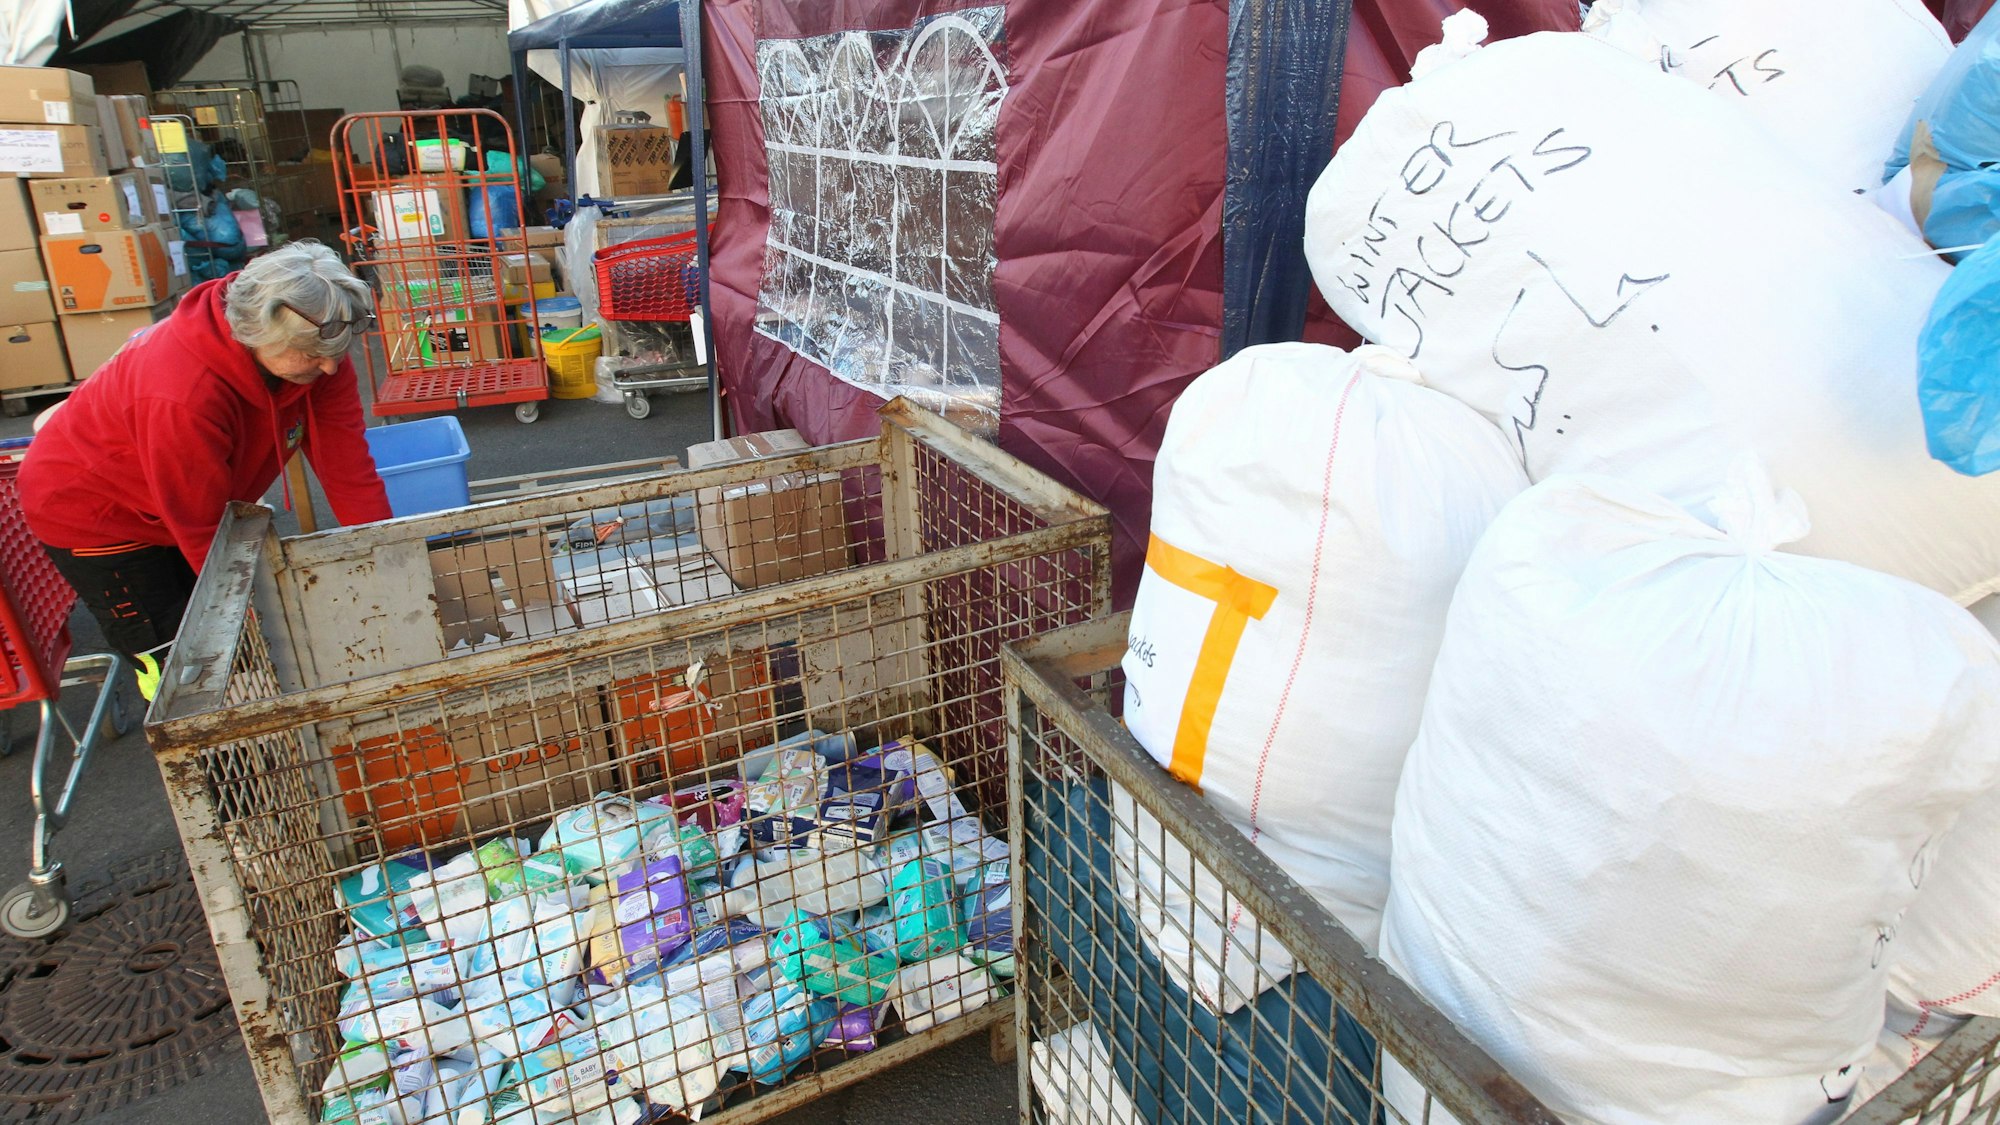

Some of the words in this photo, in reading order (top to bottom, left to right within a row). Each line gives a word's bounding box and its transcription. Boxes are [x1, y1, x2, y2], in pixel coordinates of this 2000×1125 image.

[1337, 120, 1518, 304] WINTER
[1380, 126, 1592, 360] JACKETS
[580, 1063, 597, 1076] BABY
